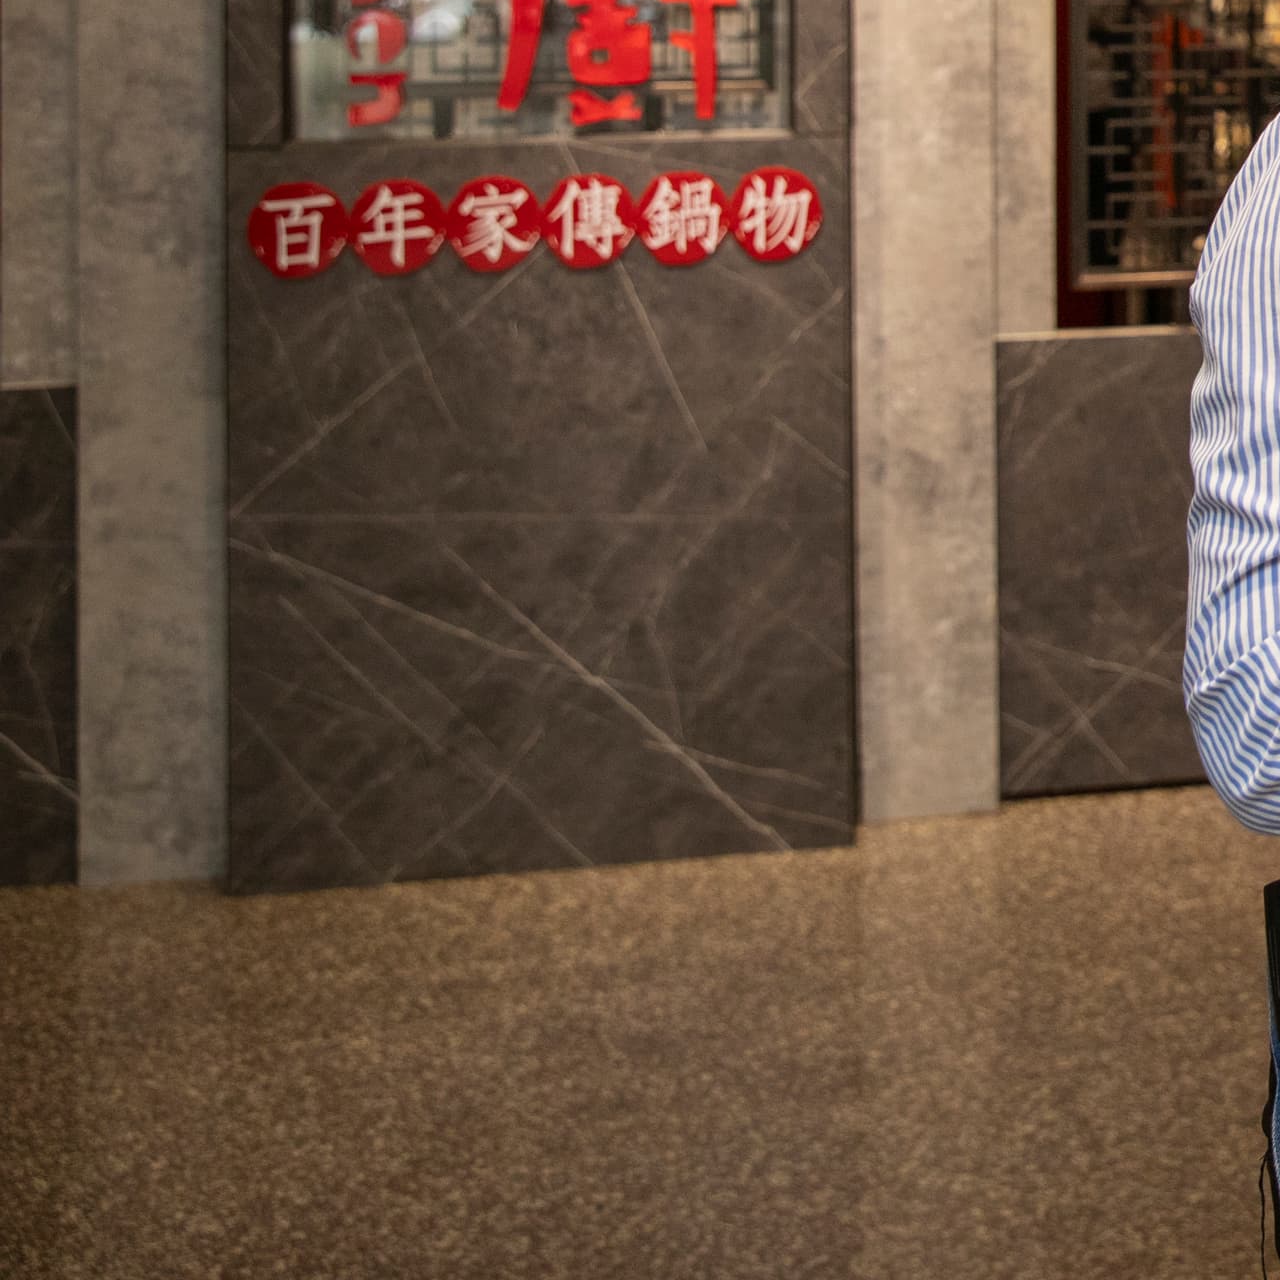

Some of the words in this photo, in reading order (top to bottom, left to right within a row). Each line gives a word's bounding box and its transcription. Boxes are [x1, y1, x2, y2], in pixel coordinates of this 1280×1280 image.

[260, 176, 812, 271] 百年家傳鍋物
